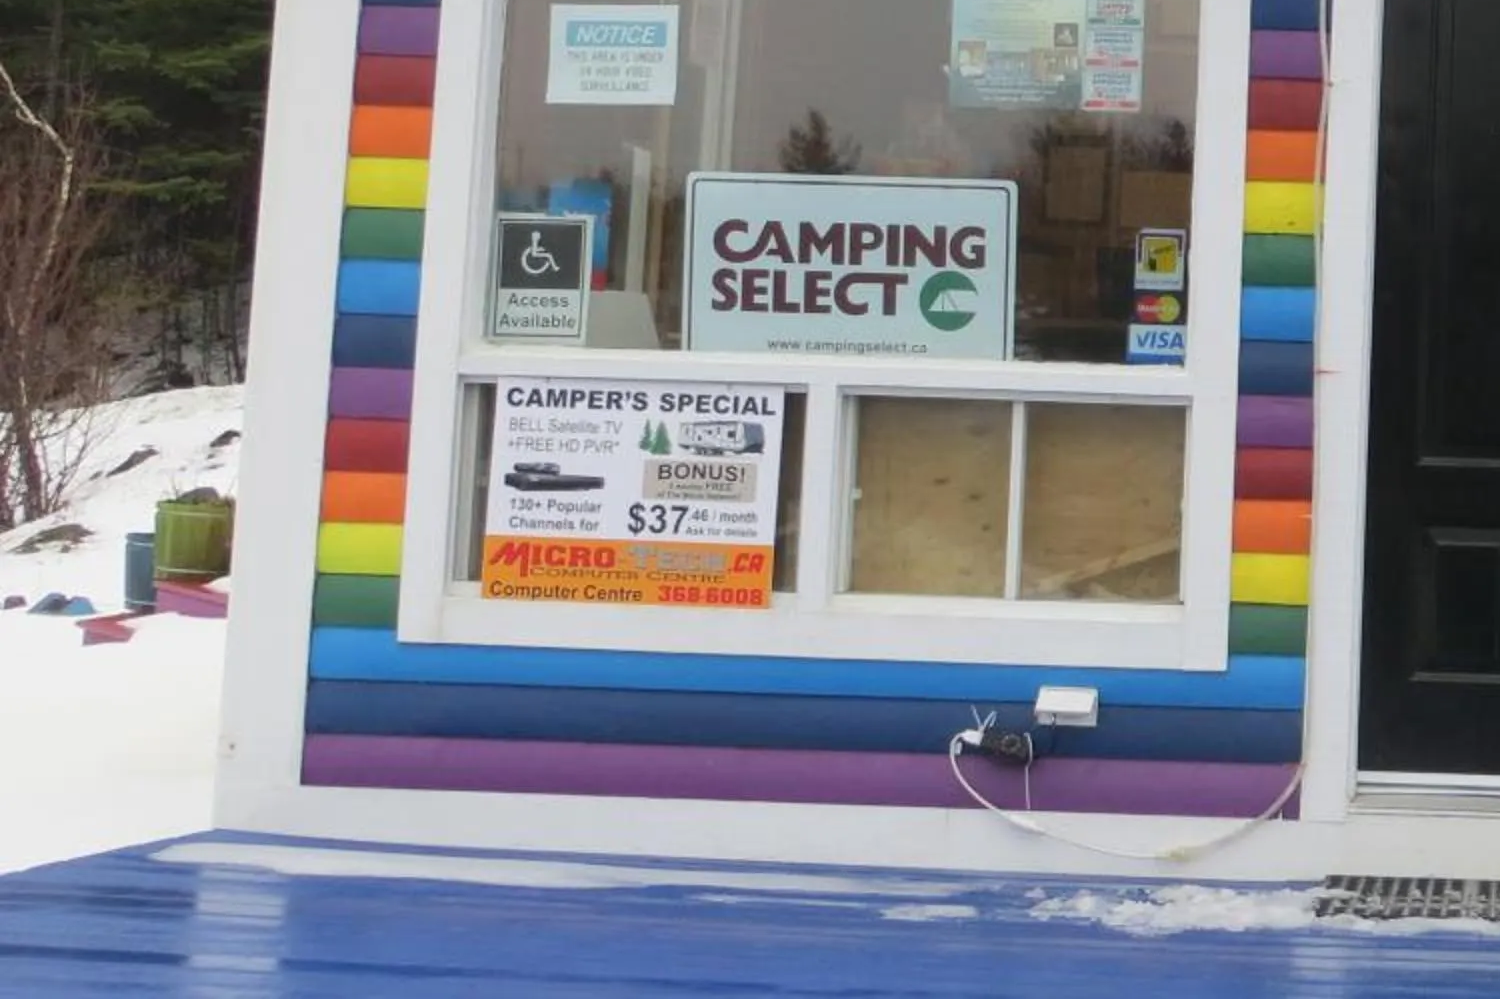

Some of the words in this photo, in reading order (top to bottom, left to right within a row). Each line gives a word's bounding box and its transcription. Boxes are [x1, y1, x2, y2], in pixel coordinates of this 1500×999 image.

[577, 24, 657, 44] NOTICE
[713, 219, 987, 269] CAMPING
[507, 292, 571, 308] Access
[711, 270, 909, 317] SELECT
[499, 312, 577, 329] Available
[766, 338, 929, 356] www.campingselect.ca
[1135, 329, 1185, 350] VISA
[507, 387, 649, 412] CAMPER'S
[659, 392, 777, 417] SPECIAL
[508, 417, 545, 432] BELL
[548, 418, 602, 434] Satellite
[603, 419, 624, 435] TV
[559, 438, 581, 453] HD
[657, 462, 745, 483] BONUS!
[510, 498, 543, 512] 130+
[546, 499, 602, 516] Popular
[508, 516, 575, 531] Channels
[579, 518, 600, 532] for
[719, 510, 758, 523] month
[529, 566, 640, 582] COMPUTER
[646, 571, 727, 585] CENTRE
[489, 579, 579, 601] Computer
[583, 584, 643, 602] Centre
[657, 586, 764, 607] 368-6008
